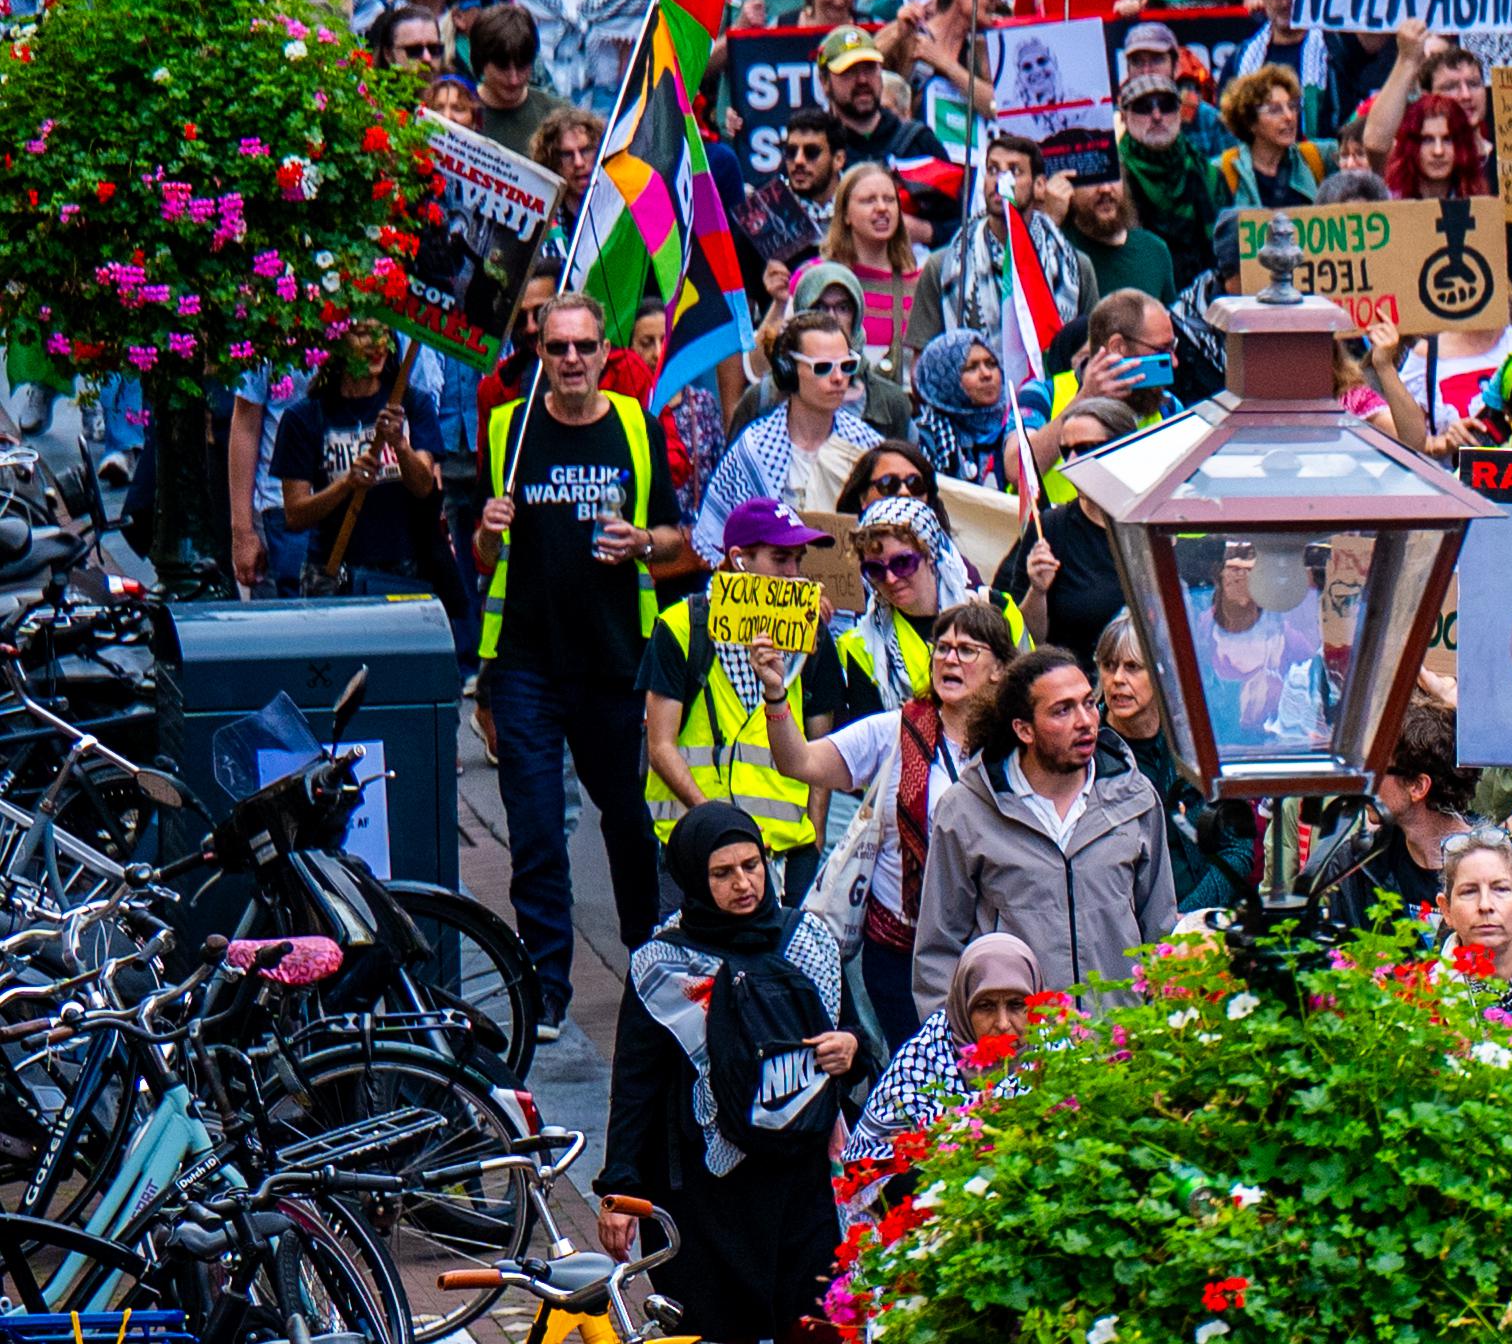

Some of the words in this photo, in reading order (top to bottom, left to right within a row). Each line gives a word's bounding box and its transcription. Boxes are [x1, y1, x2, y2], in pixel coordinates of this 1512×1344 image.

[1240, 212, 1390, 260] GENOCDE
[1290, 257, 1373, 295] TEGE
[550, 465, 620, 484] GELIJK
[719, 574, 761, 607] YOUR
[766, 579, 817, 608] SILENCE
[713, 615, 732, 642] IS
